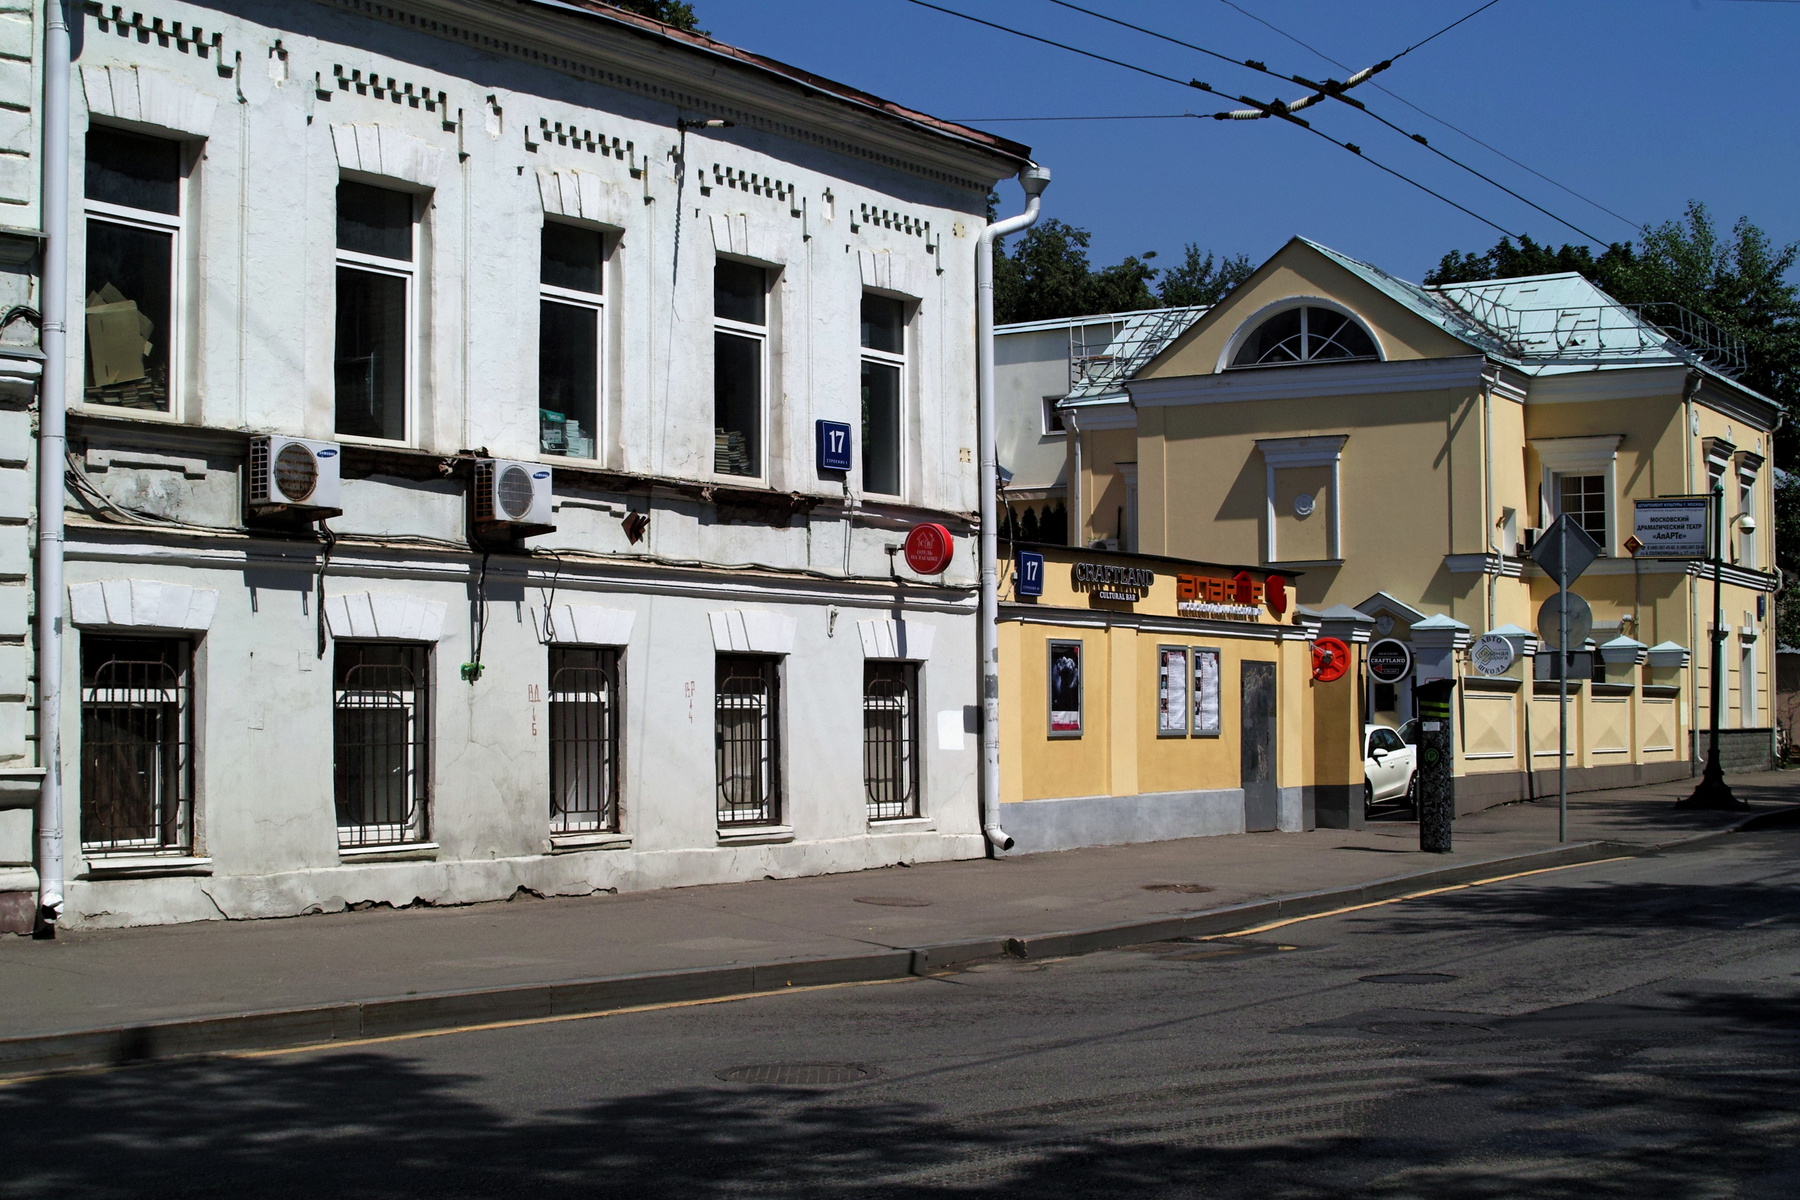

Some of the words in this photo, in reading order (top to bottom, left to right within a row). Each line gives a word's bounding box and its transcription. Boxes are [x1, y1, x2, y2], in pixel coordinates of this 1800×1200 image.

[829, 430, 845, 453] 17
[1637, 523, 1685, 531] ДРАМАТИЧЕСКИЙ
[1026, 560, 1038, 581] 17
[1076, 562, 1154, 587] CRAFTLAND
[1099, 591, 1125, 601] CULTURAL
[1126, 593, 1136, 601] BAR
[1481, 635, 1502, 645] АВТО
[1477, 664, 1505, 675] ШКОЛА
